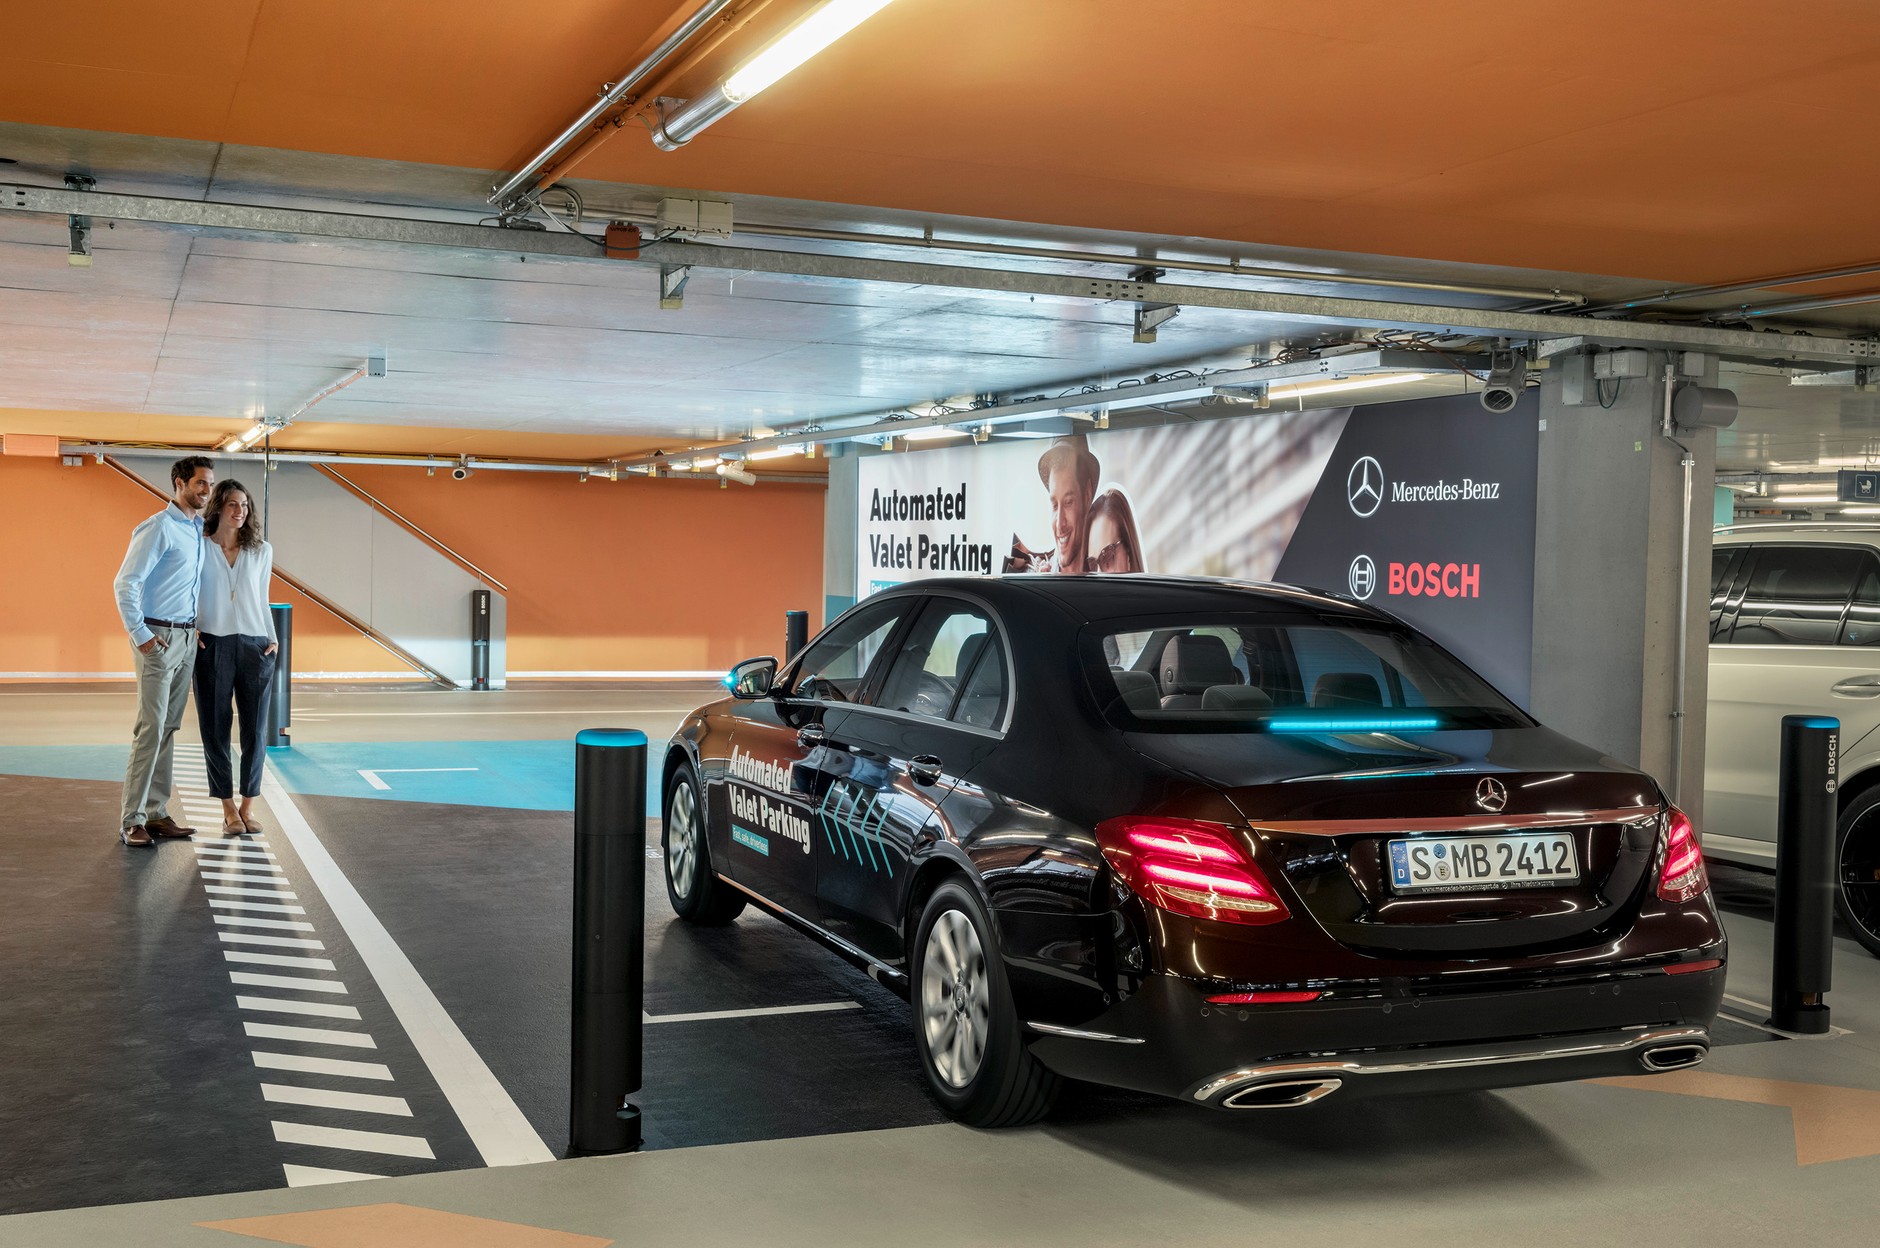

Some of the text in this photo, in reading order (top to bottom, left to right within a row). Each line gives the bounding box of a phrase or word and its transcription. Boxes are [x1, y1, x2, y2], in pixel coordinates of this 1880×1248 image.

[870, 483, 966, 521] Automated
[1391, 478, 1500, 502] Mercedes-Benz
[870, 534, 992, 575] Valet Parking
[1388, 562, 1480, 598] BOSCH
[728, 744, 794, 795] Automated
[1828, 735, 1837, 775] BOSCH
[728, 784, 810, 855] Valet Parking
[1398, 869, 1405, 879] D
[1411, 841, 1571, 880] S MB 2412
